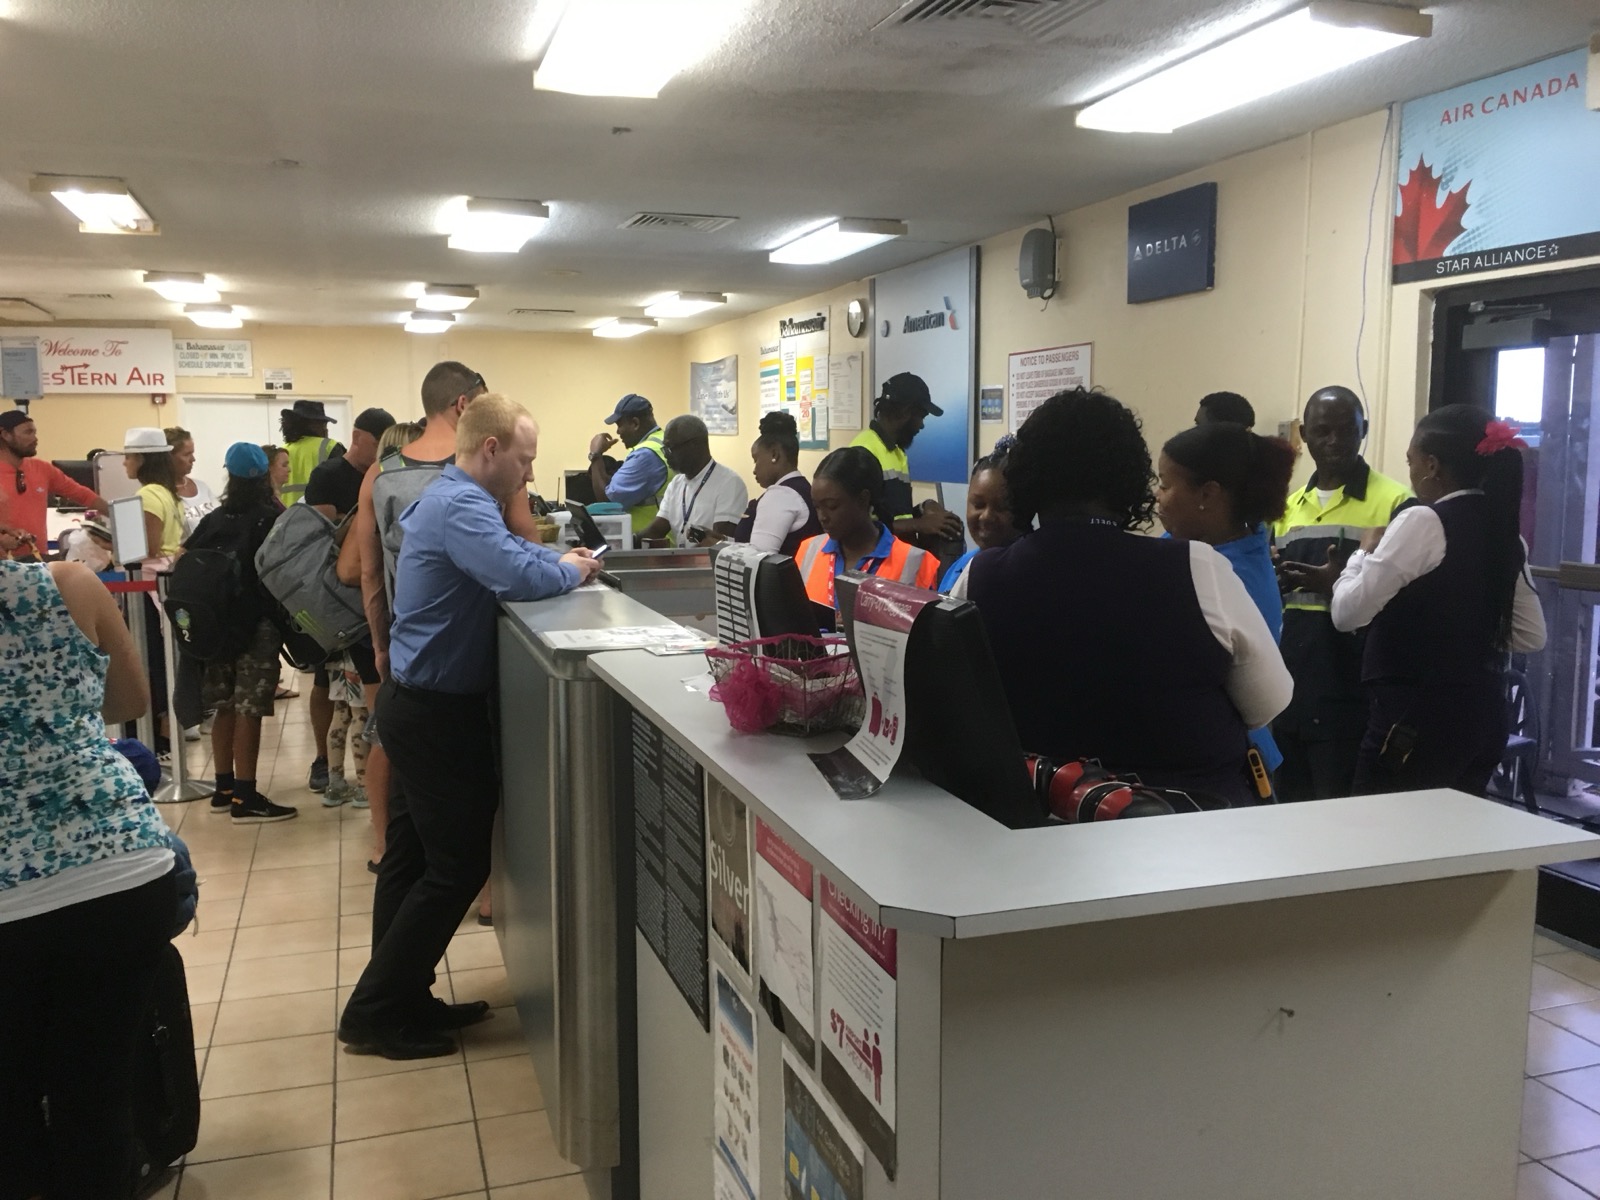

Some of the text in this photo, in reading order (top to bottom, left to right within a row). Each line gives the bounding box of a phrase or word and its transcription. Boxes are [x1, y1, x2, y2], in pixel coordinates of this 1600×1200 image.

[1440, 72, 1580, 126] AIR CANADA
[1145, 234, 1188, 257] DELTA
[1436, 245, 1547, 274] STAR ALLIANCE
[902, 310, 945, 334] American
[40, 337, 129, 357] Welcome To
[1020, 350, 1079, 367] NOTICE TO PASSENGERS
[42, 363, 117, 386] ESTERN
[126, 366, 165, 386] AIR
[182, 629, 191, 642] 2
[710, 840, 750, 915] Silver
[830, 1008, 845, 1049] $7
